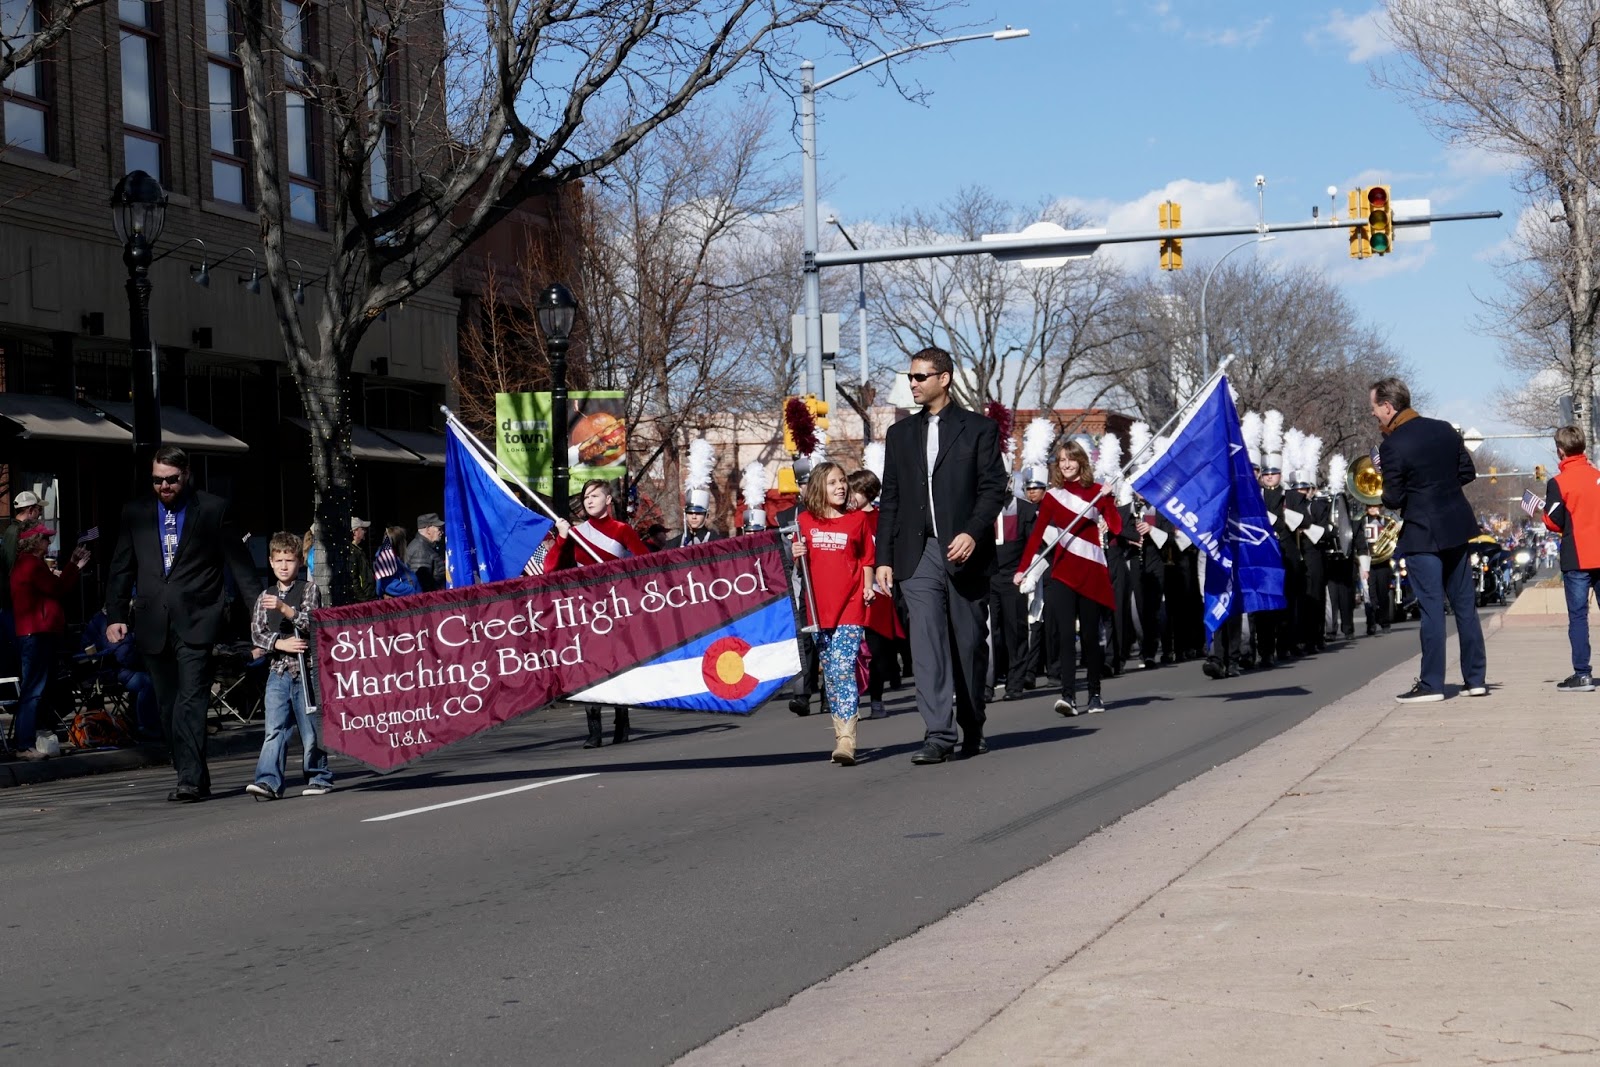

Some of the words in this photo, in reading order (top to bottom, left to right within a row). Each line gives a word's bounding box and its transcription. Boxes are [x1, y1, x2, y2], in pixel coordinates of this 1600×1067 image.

[1165, 496, 1199, 533] U.S.
[330, 626, 429, 662] Silver
[436, 597, 548, 647] Creek
[551, 586, 634, 635] High
[639, 557, 770, 613] School
[333, 658, 491, 700] Marching
[495, 633, 585, 676] Band
[443, 694, 483, 717] CO
[388, 728, 432, 749] U.S.A.
